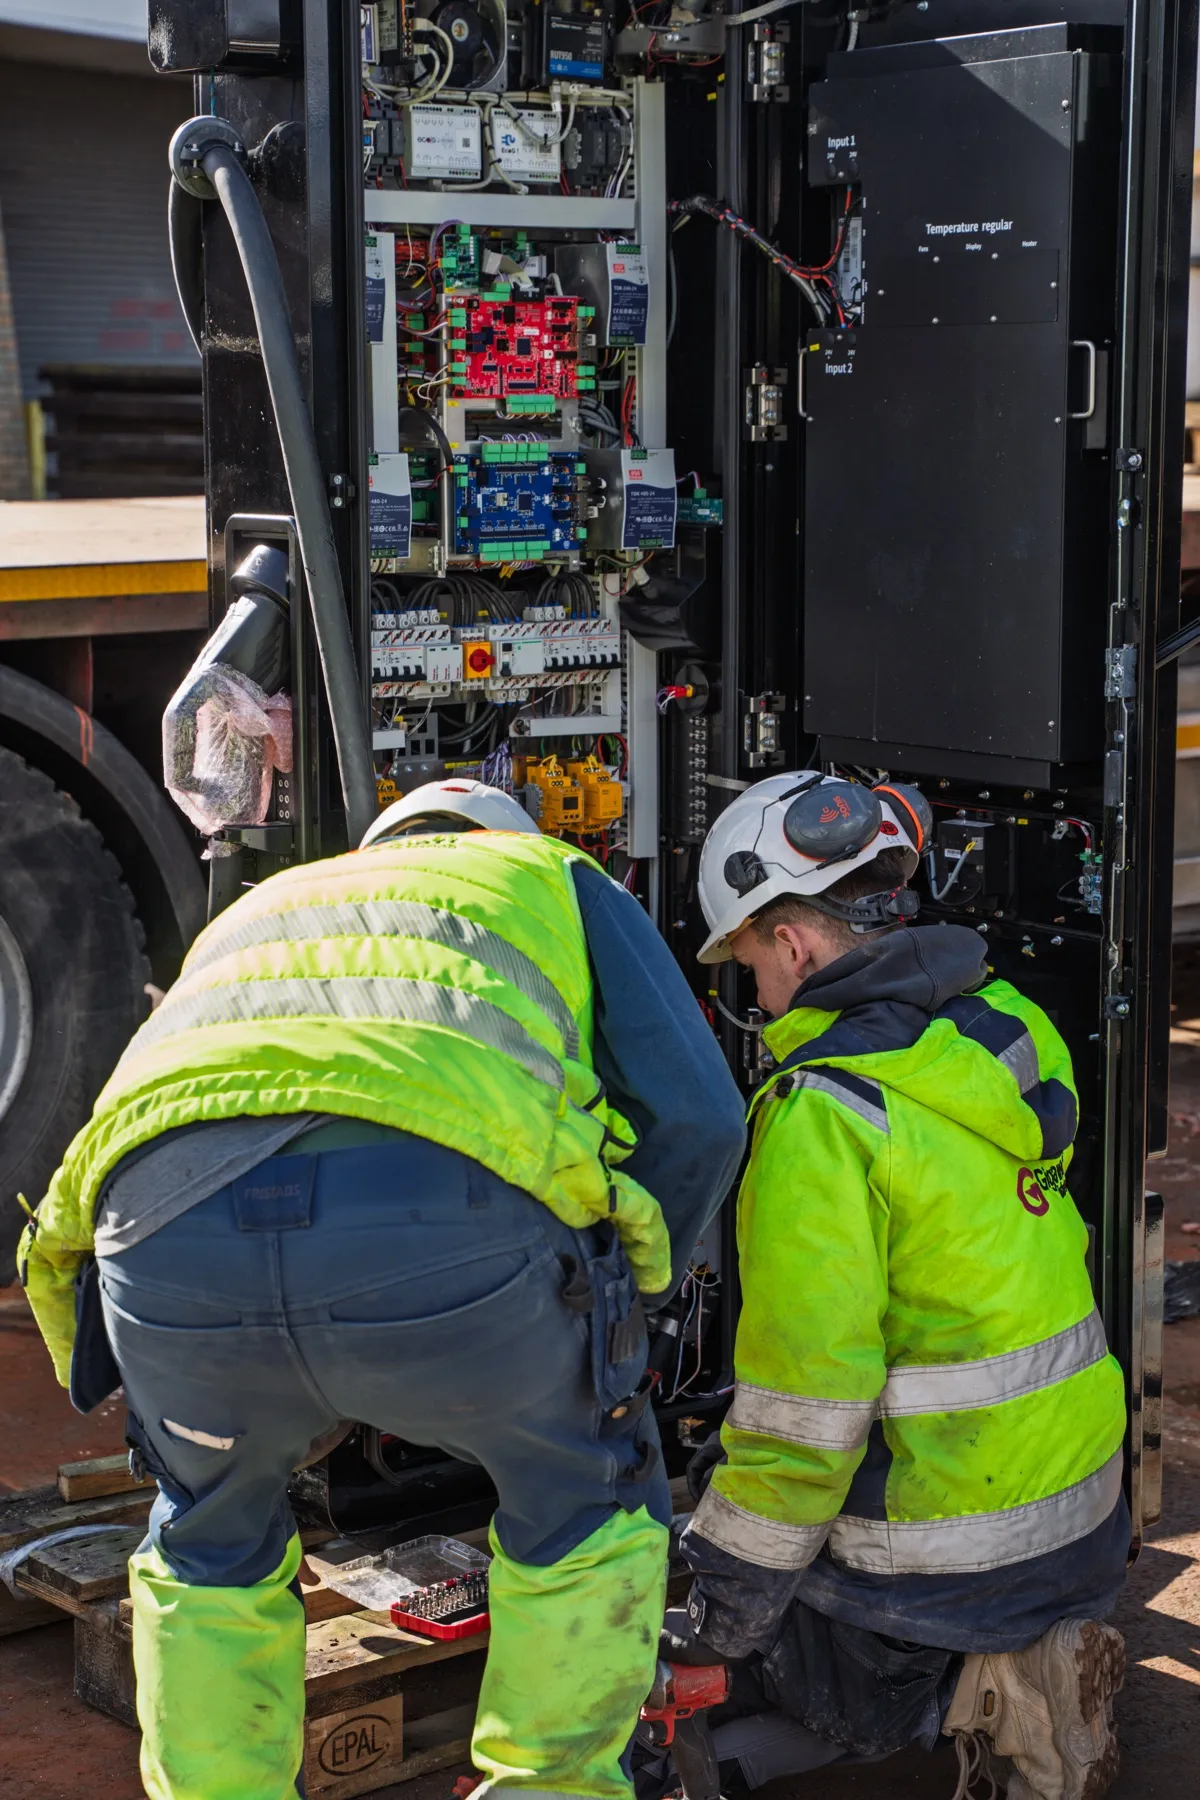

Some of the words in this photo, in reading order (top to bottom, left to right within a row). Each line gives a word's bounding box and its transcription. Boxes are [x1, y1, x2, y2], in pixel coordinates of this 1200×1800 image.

[827, 136, 850, 150] Input
[850, 134, 856, 147] 1
[925, 222, 979, 236] Temperature
[981, 218, 1013, 234] regular
[965, 242, 982, 251] Display
[825, 363, 847, 376] Input
[847, 362, 853, 373] 2
[331, 1723, 384, 1768] EPAL
